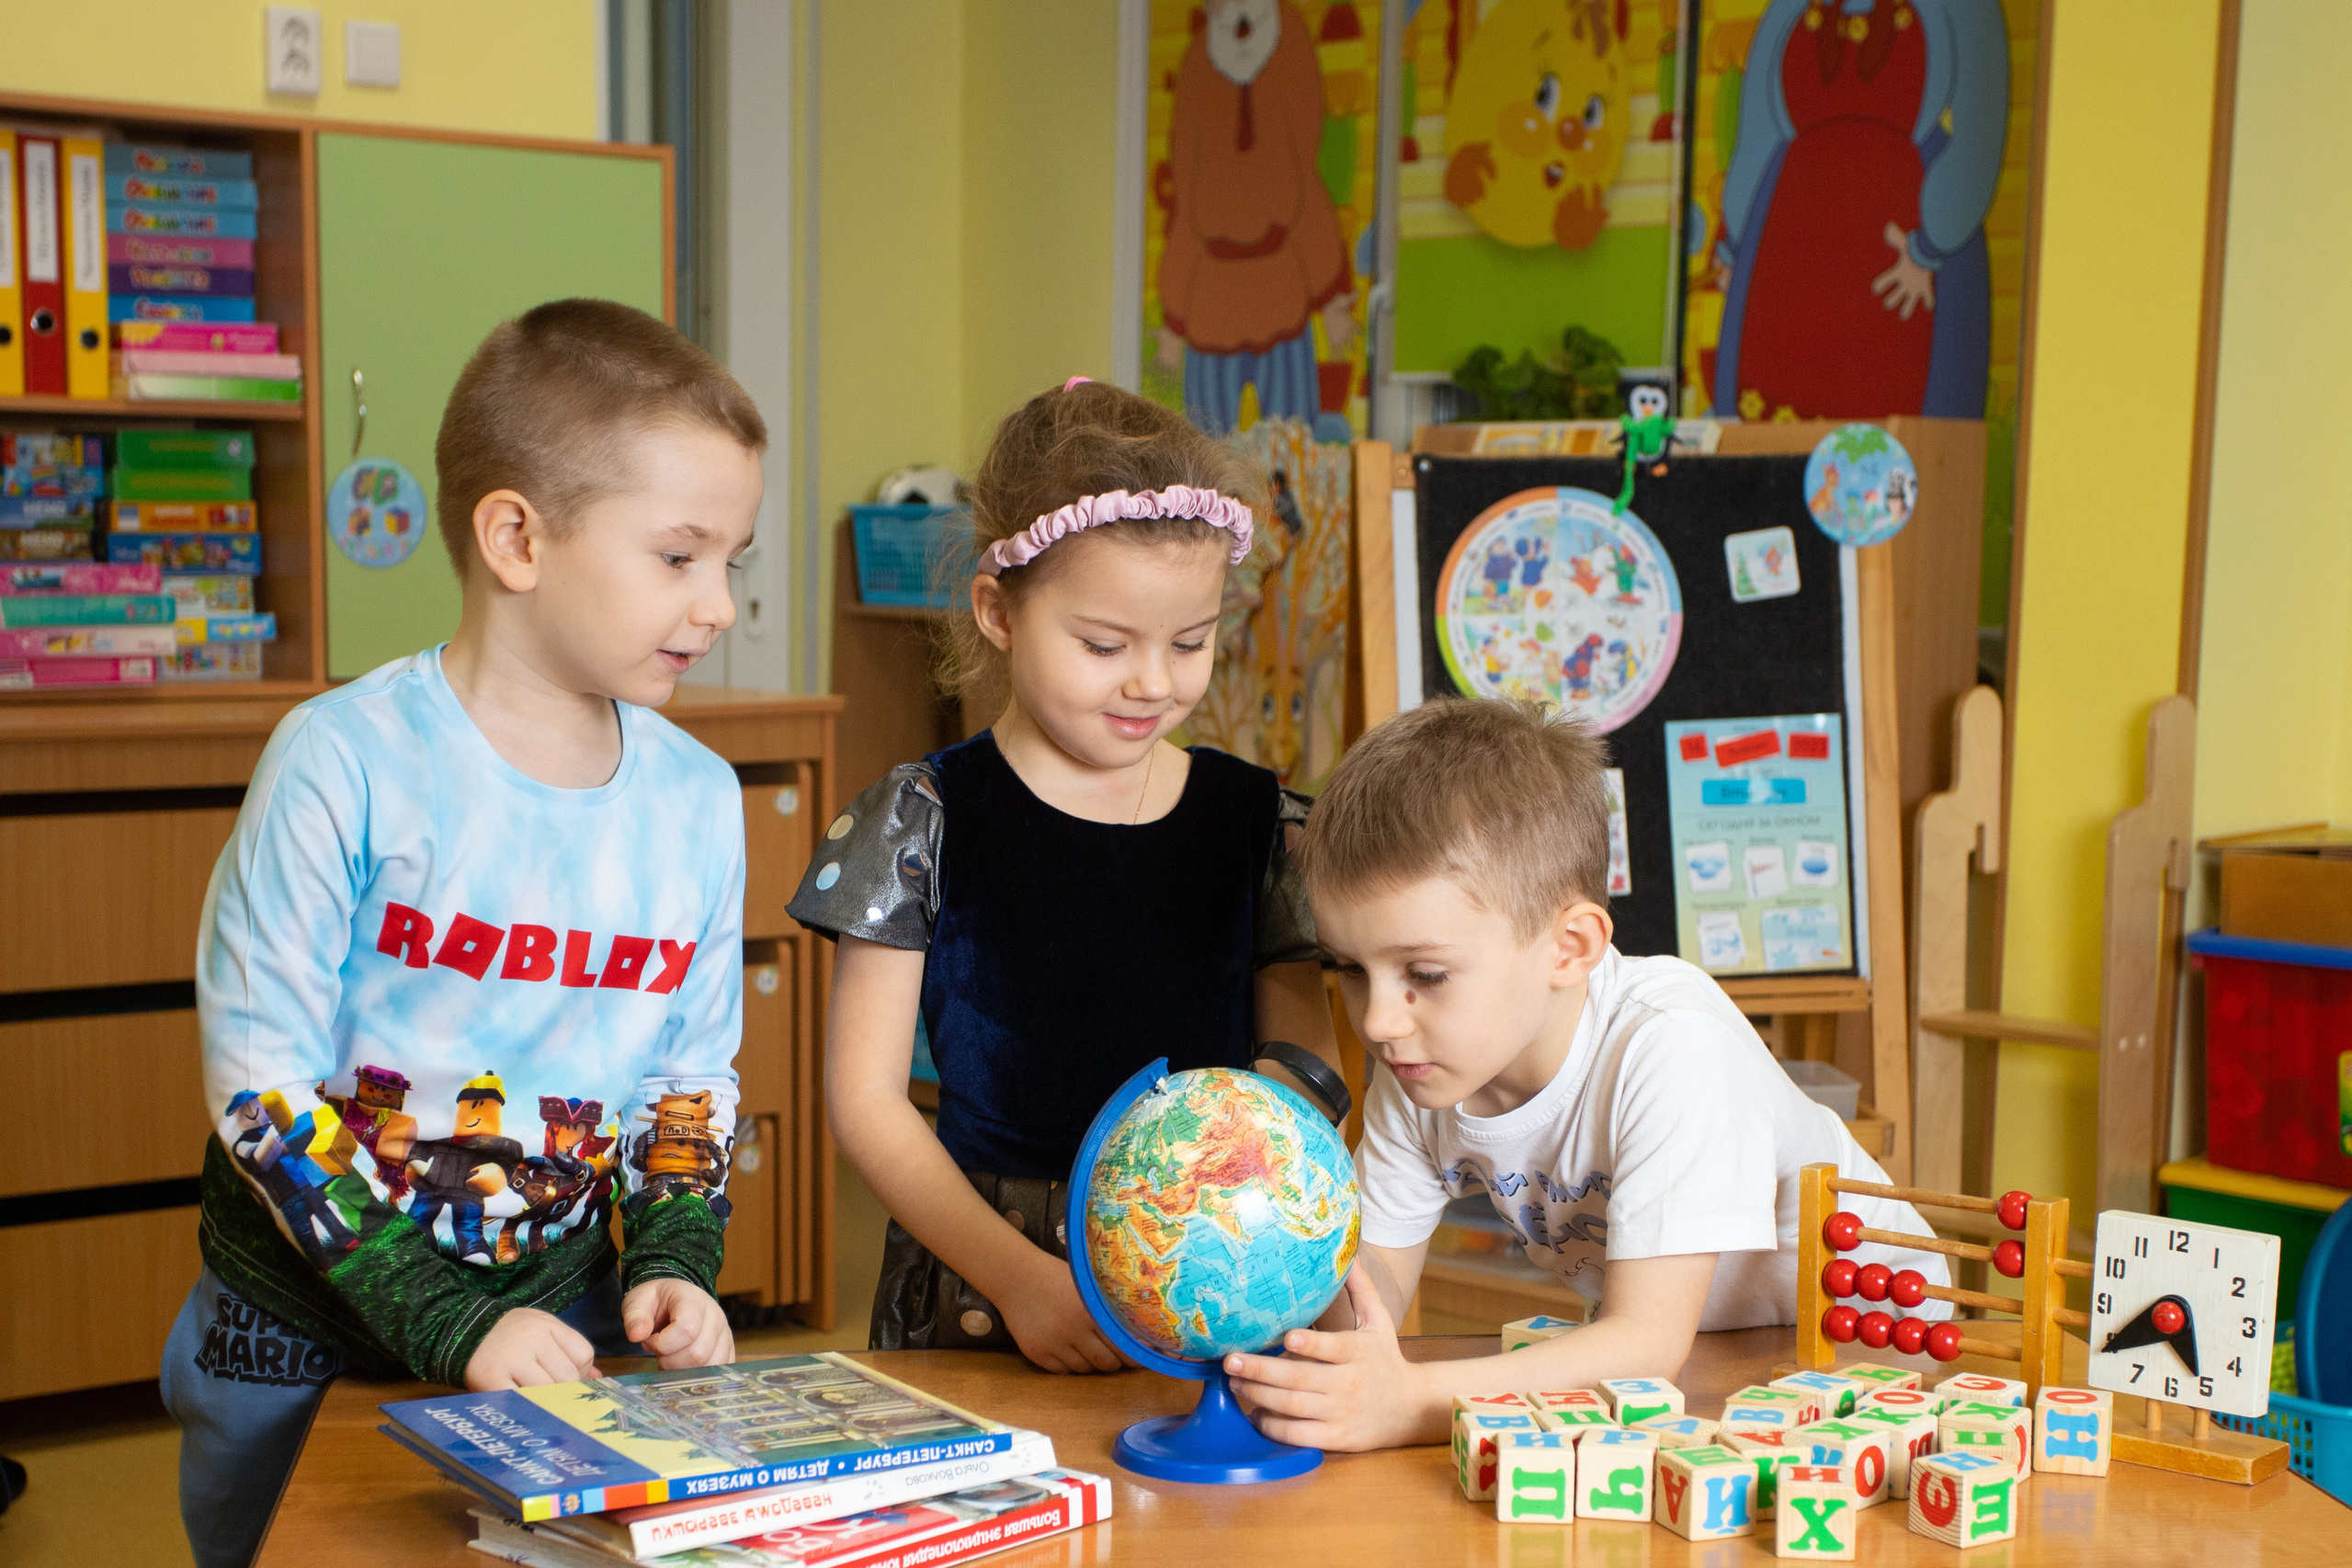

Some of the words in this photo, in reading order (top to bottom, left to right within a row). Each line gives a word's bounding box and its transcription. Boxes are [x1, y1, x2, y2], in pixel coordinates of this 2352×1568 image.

[376, 901, 697, 995] ROBLOX
[2134, 1236, 2148, 1258] 11
[2169, 1230, 2189, 1253] 12
[2106, 1256, 2126, 1279] 10
[2214, 1247, 2220, 1269] 1
[2231, 1277, 2246, 1298] 2
[2097, 1292, 2112, 1314] 9
[2242, 1317, 2256, 1338] 3
[194, 1321, 338, 1386] MARIO
[2129, 1363, 2145, 1384] 7
[2227, 1357, 2242, 1377] 4
[1784, 1372, 1851, 1390] М
[2165, 1376, 2178, 1398] 6
[2199, 1376, 2214, 1398] 5
[1873, 1391, 1926, 1404] О
[2046, 1391, 2098, 1403] О
[464, 1403, 534, 1438] МУЗЕЯХ
[425, 1407, 564, 1485] САНКТ-ПЕТЕРБУРГ
[521, 1437, 549, 1448] О
[2046, 1408, 2100, 1462] Н
[536, 1447, 608, 1477] ДЕТЯМ
[852, 1438, 996, 1473] САНКТ-ПЕТЕРБУРГ
[756, 1471, 769, 1485] О
[773, 1459, 831, 1483] ДЕТЯМ
[904, 1468, 954, 1486] Волкова
[955, 1461, 990, 1477] Ольга
[1855, 1445, 1885, 1498] О
[686, 1474, 754, 1495] МУЗЕЯХ
[1511, 1466, 1567, 1520] П
[1660, 1465, 1688, 1525] А
[1703, 1474, 1753, 1535] Й
[1004, 1508, 1062, 1539] Большая
[902, 1526, 1003, 1567] энциклопедия
